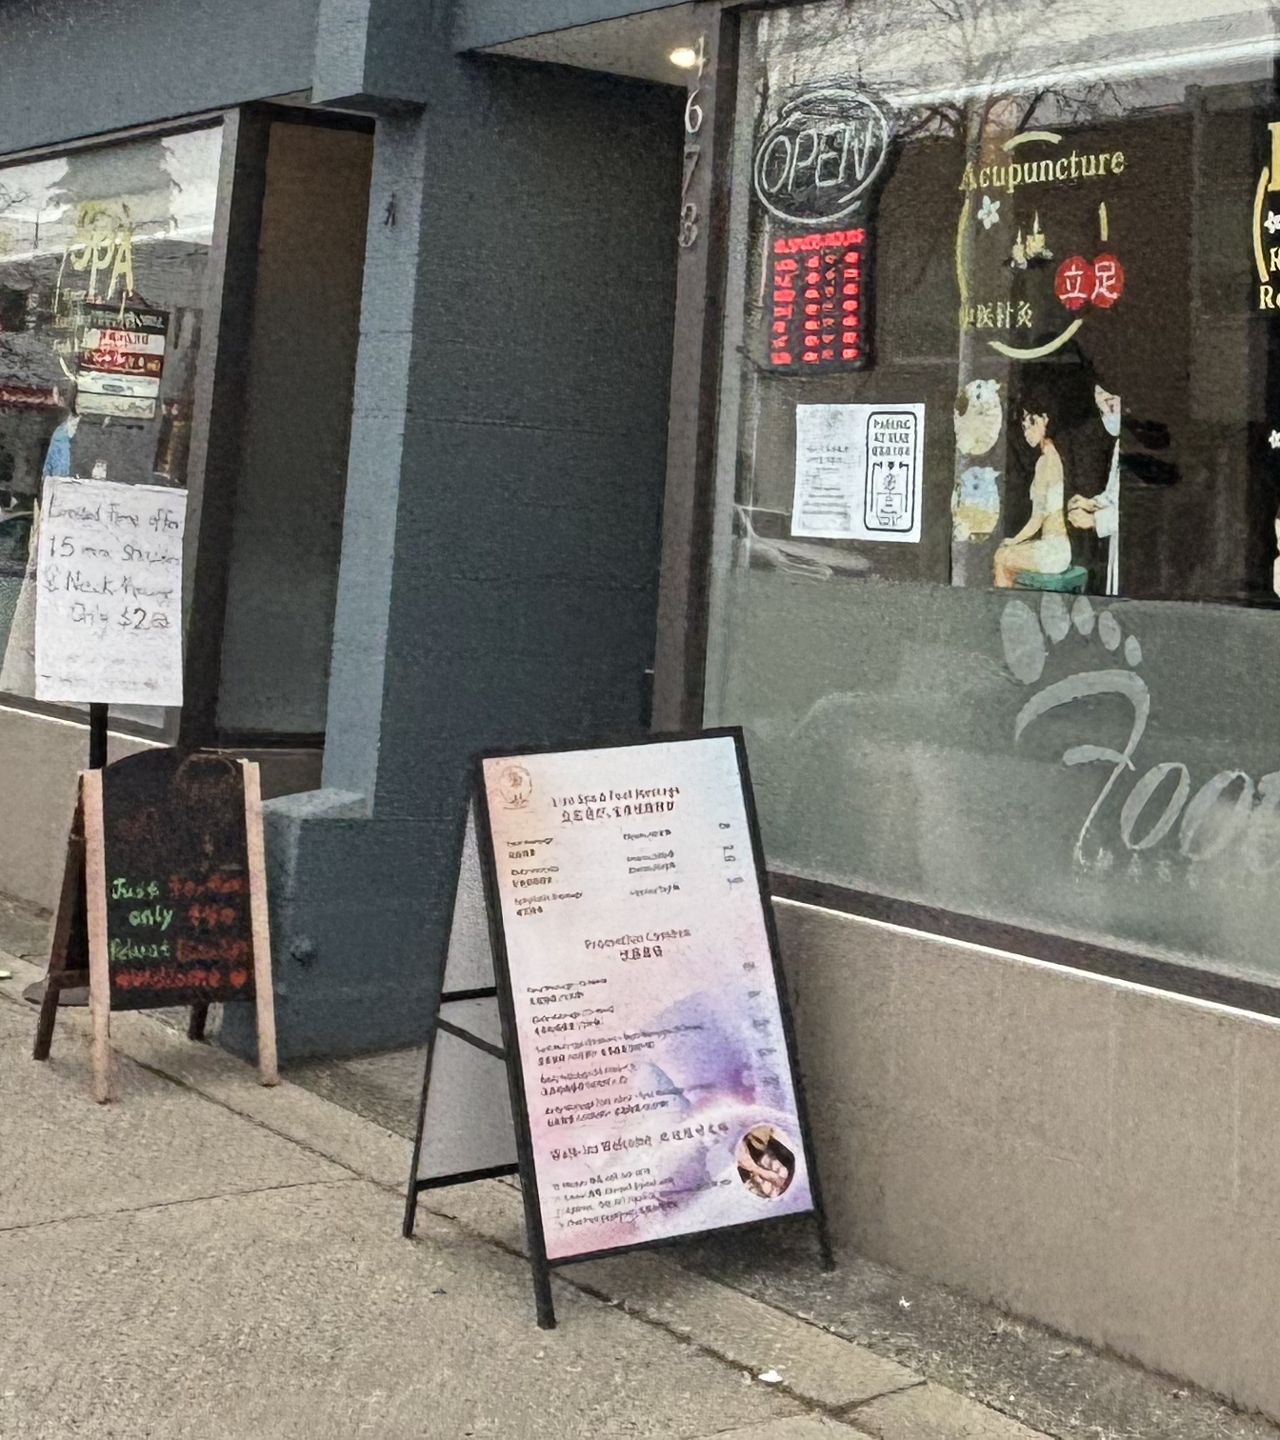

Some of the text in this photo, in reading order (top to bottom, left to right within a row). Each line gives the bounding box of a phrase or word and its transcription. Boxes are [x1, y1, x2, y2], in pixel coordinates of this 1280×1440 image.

[762, 120, 873, 193] OPEN
[958, 150, 1125, 194] Acupuncture
[1058, 261, 1119, 301] 立足
[50, 535, 75, 558] 15
[128, 905, 174, 931] only
